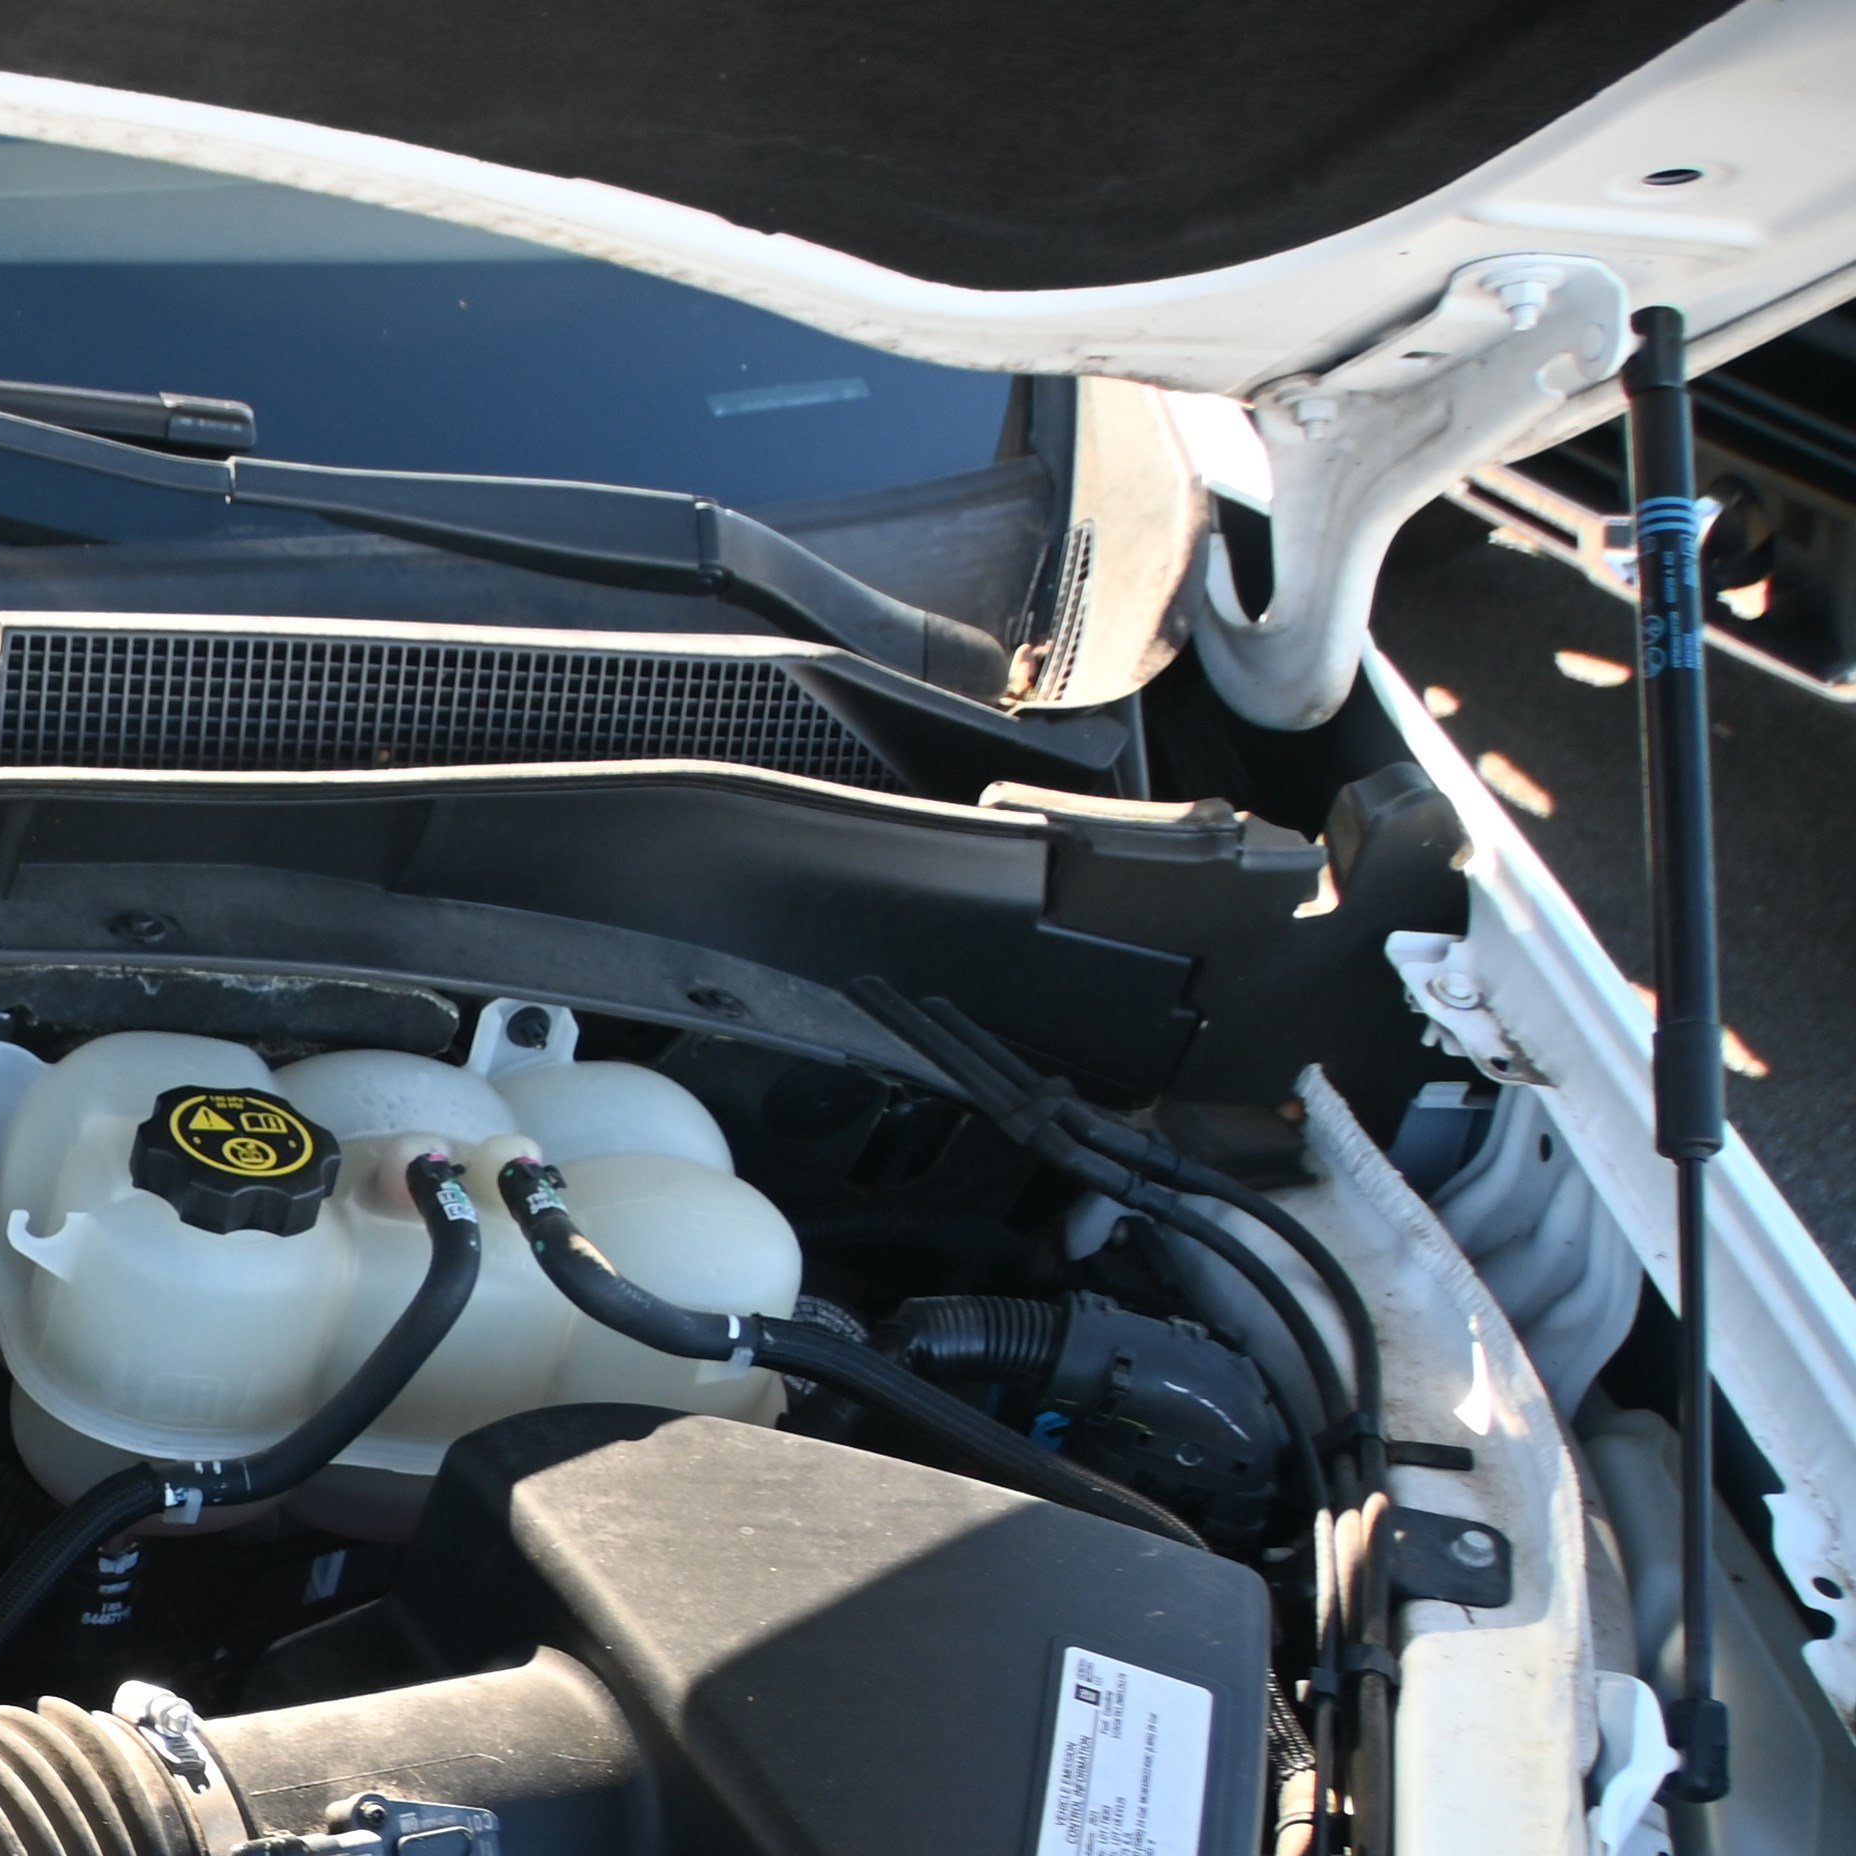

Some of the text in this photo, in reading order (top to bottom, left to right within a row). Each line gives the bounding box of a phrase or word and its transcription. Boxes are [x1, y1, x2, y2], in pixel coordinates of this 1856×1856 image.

[1055, 1740, 1077, 1827] VEHICLE EMISSION
[1065, 1734, 1092, 1845] CONTROL INFORMATION
